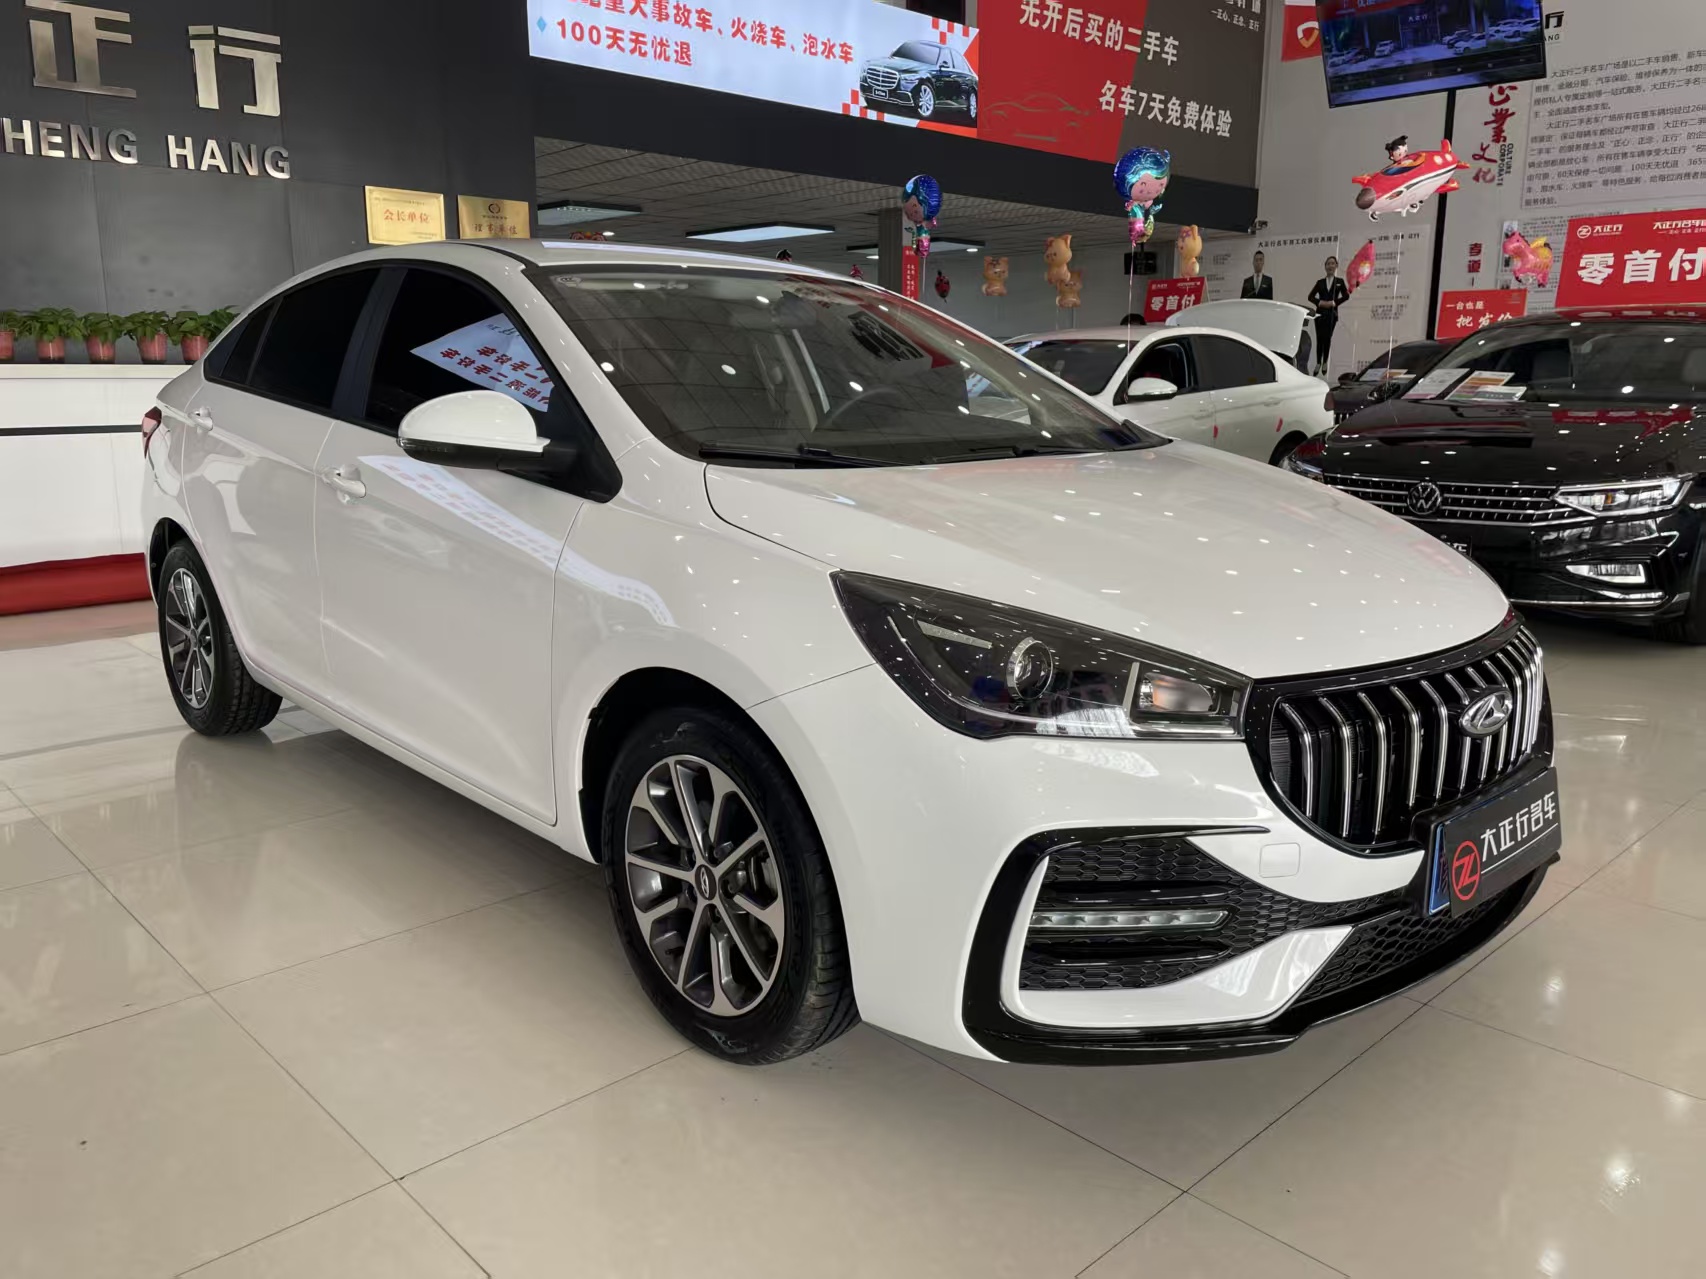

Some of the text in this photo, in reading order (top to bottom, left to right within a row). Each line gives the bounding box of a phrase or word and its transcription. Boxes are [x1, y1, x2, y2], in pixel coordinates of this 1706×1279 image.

[556, 18, 692, 66] 100天无忧退
[1098, 80, 1233, 138] 名车7天免费体验
[0, 117, 291, 179] HENG HANG
[1593, 223, 1623, 233] 大正行
[1577, 246, 1706, 286] 零首付
[1150, 294, 1196, 311] 零首付
[1480, 790, 1556, 863] 大正行名车
